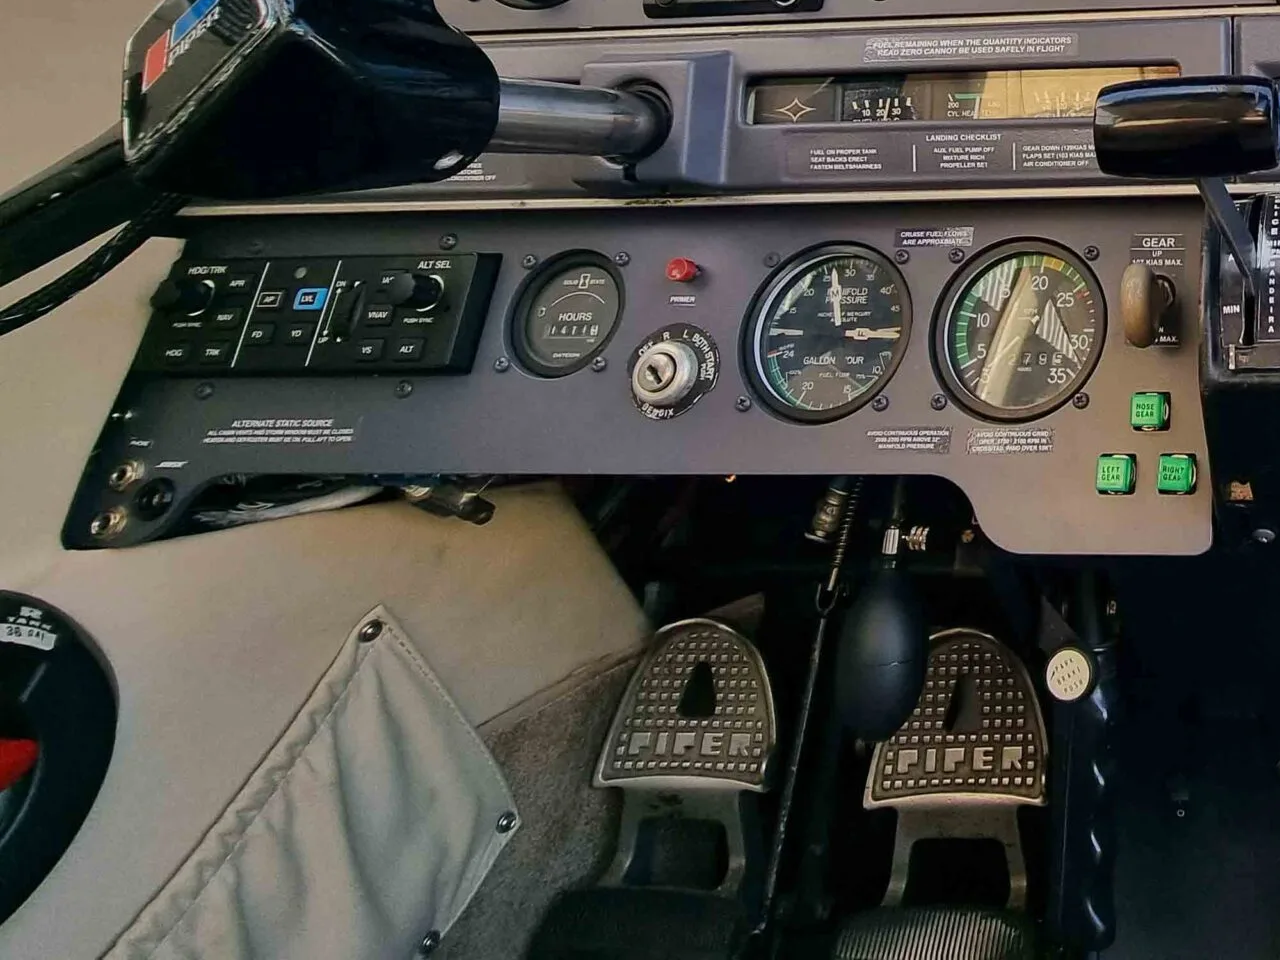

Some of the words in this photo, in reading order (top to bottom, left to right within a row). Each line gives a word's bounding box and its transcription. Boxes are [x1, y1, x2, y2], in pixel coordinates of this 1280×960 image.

[896, 40, 938, 48] REMAINING
[983, 37, 1022, 45] QUANTITY
[995, 45, 1025, 53] SAFELY
[1142, 237, 1175, 248] GEAR
[418, 261, 433, 269] ALT
[434, 260, 451, 269] SEL
[1032, 276, 1048, 290] 20
[1057, 293, 1074, 307] 25
[559, 312, 592, 321] HOURS
[1223, 305, 1240, 314] MIN
[977, 313, 990, 327] 10
[1071, 335, 1088, 349] 30
[1048, 368, 1066, 383] 35
[629, 732, 751, 755] PIPER
[897, 745, 1023, 772] PIPER
